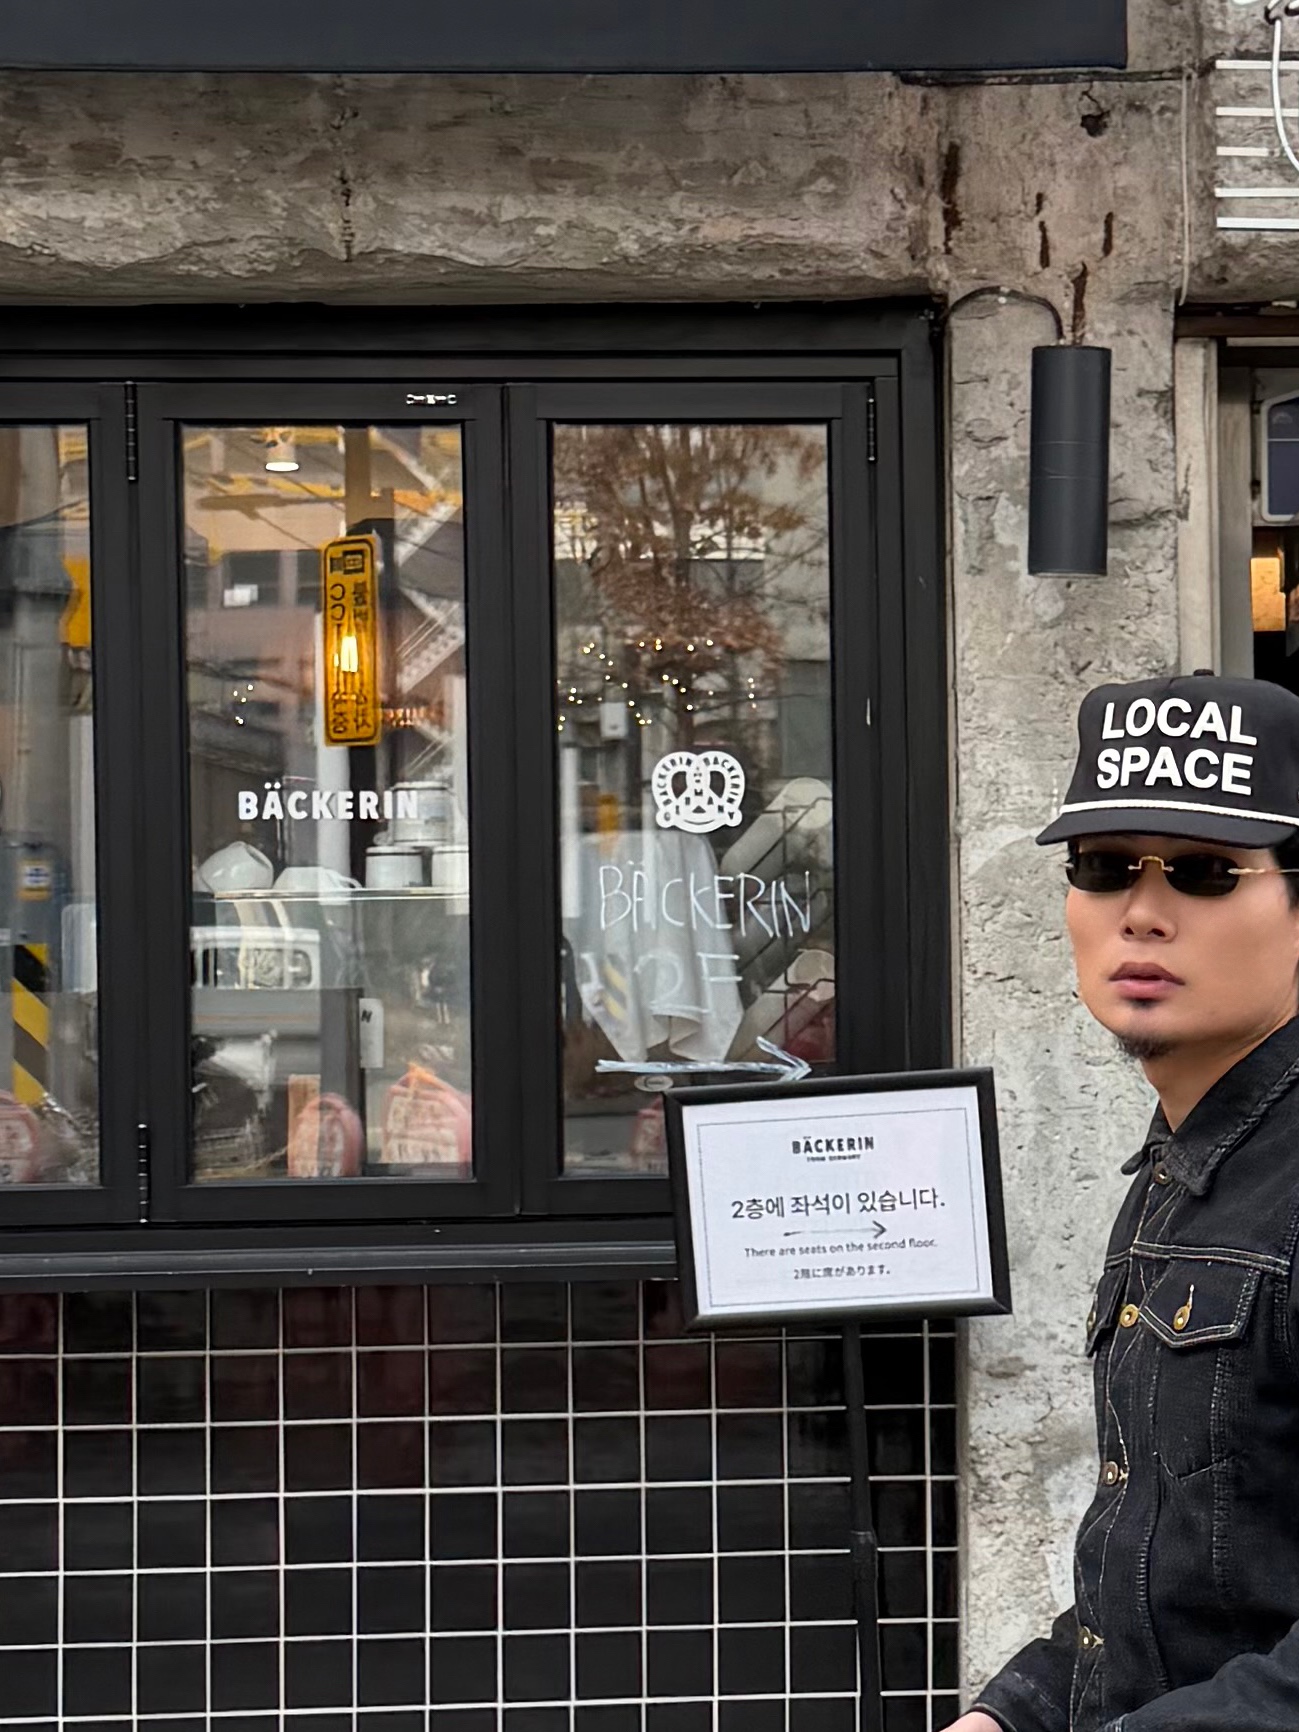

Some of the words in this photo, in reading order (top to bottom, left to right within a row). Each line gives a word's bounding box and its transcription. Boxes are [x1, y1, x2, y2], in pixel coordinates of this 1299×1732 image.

[1101, 697, 1258, 747] LOCAL
[1096, 746, 1254, 796] SPACE
[238, 781, 419, 821] BÄCKERIN
[791, 1135, 875, 1155] BÄCKERIN
[731, 1195, 785, 1220] 2층에
[790, 1191, 851, 1217] 좌석이
[857, 1187, 946, 1213] 있습니다.
[744, 1246, 776, 1258] There
[778, 1246, 796, 1257] are
[798, 1244, 828, 1256] seats
[829, 1244, 844, 1254] on
[845, 1240, 864, 1253] the
[866, 1237, 906, 1251] second
